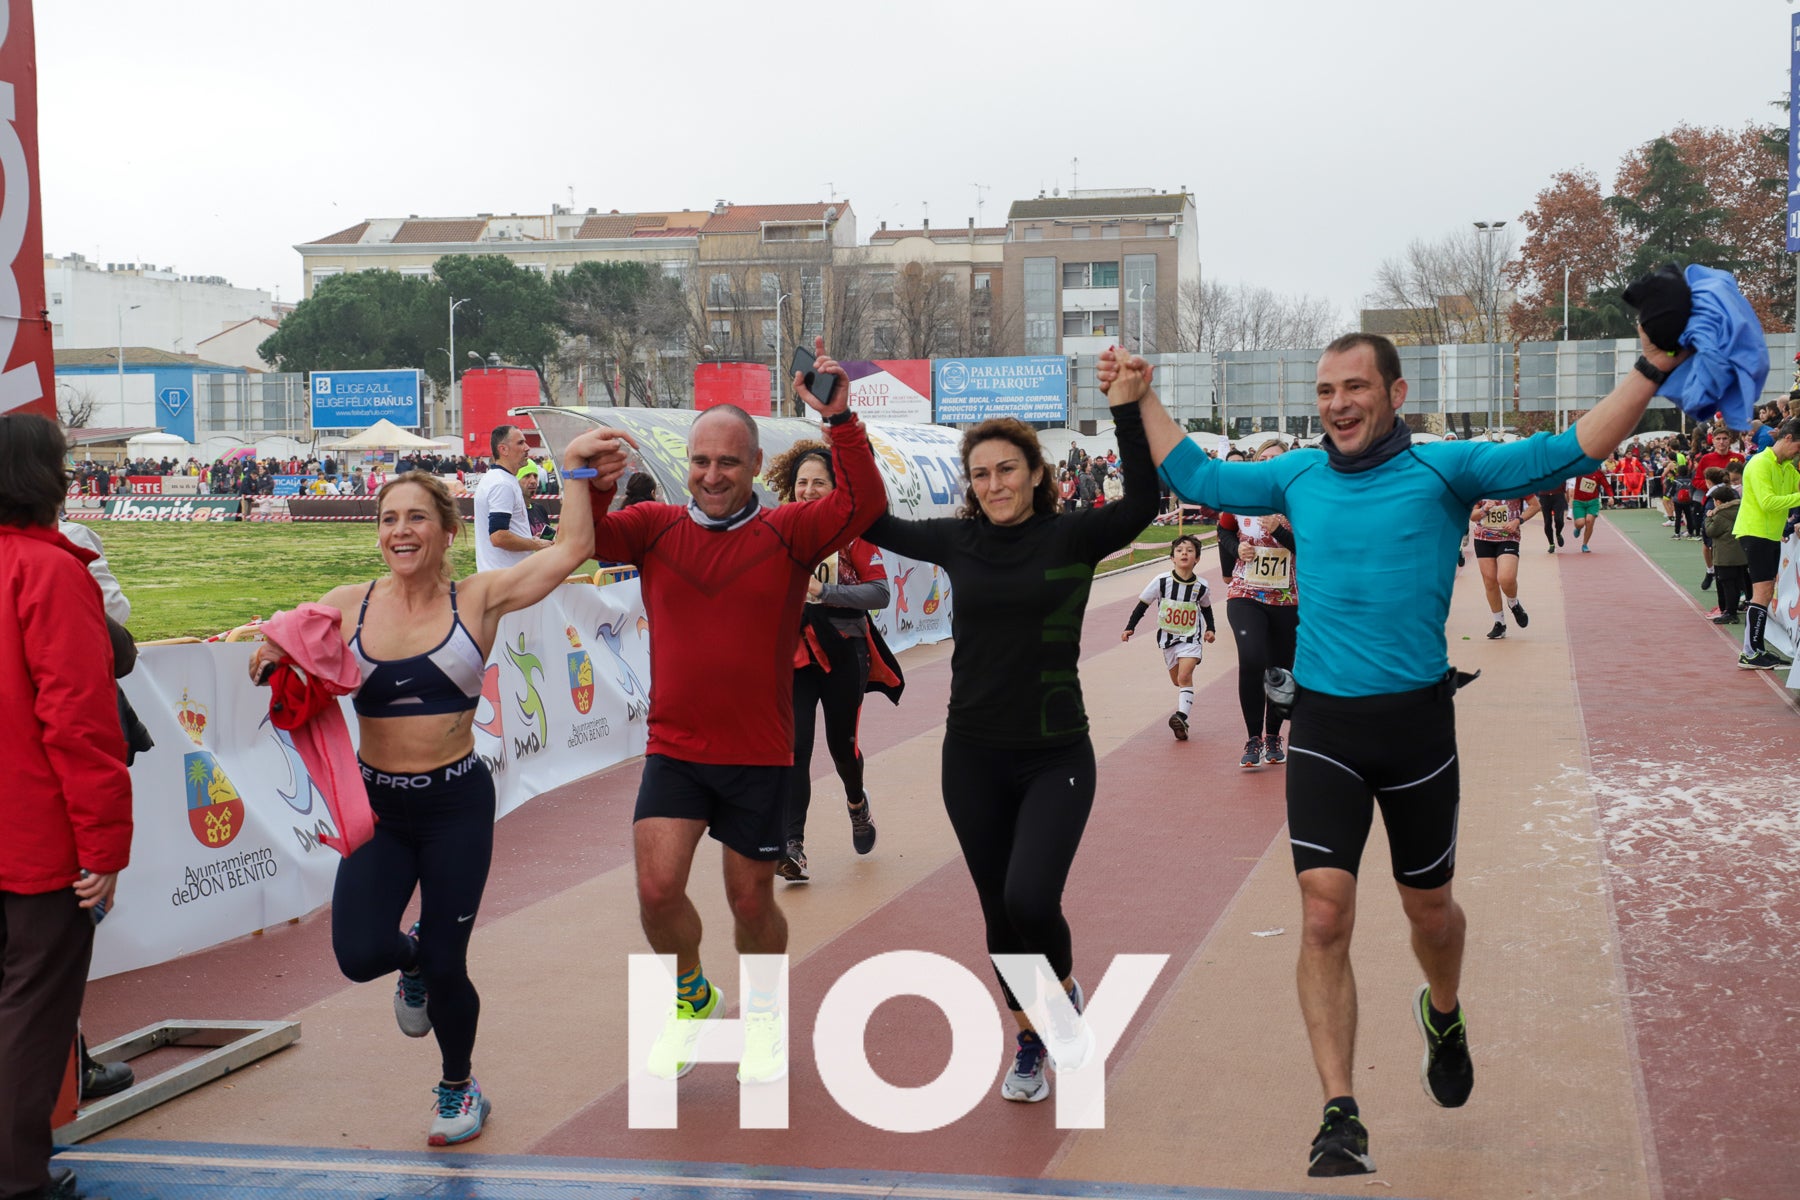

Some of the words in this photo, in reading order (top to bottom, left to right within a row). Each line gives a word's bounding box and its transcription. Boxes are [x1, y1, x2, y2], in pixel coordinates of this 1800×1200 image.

[970, 364, 1063, 377] PARAFARMACIA
[336, 384, 365, 394] ELIGE
[365, 383, 392, 394] AZUL
[316, 397, 344, 408] ELIGE
[346, 396, 373, 408] FÉLIX
[373, 394, 414, 407] BAÑULS
[849, 393, 889, 407] FRUIT
[941, 396, 967, 404] HIGIENE
[969, 396, 989, 404] BUCAL
[995, 395, 1024, 403] CUIDADO
[939, 404, 978, 412] PRODUCTOS
[985, 403, 1033, 411] ALIMENTACIÓN
[941, 412, 976, 420] DIETÉTICA
[977, 412, 982, 420] Y
[1023, 411, 1061, 419] ORTOPEDIA
[1584, 481, 1595, 490] 727
[1486, 510, 1508, 523] 1596
[1253, 555, 1287, 577] 1571
[1165, 607, 1197, 627] 3609
[572, 717, 608, 735] Ayuntamiento
[589, 724, 610, 741] BENITO
[514, 732, 540, 760] DMD
[376, 774, 432, 789] PRO
[184, 847, 273, 886] Ayuntamiento
[171, 875, 225, 906] deDON
[226, 858, 278, 889] BENITO
